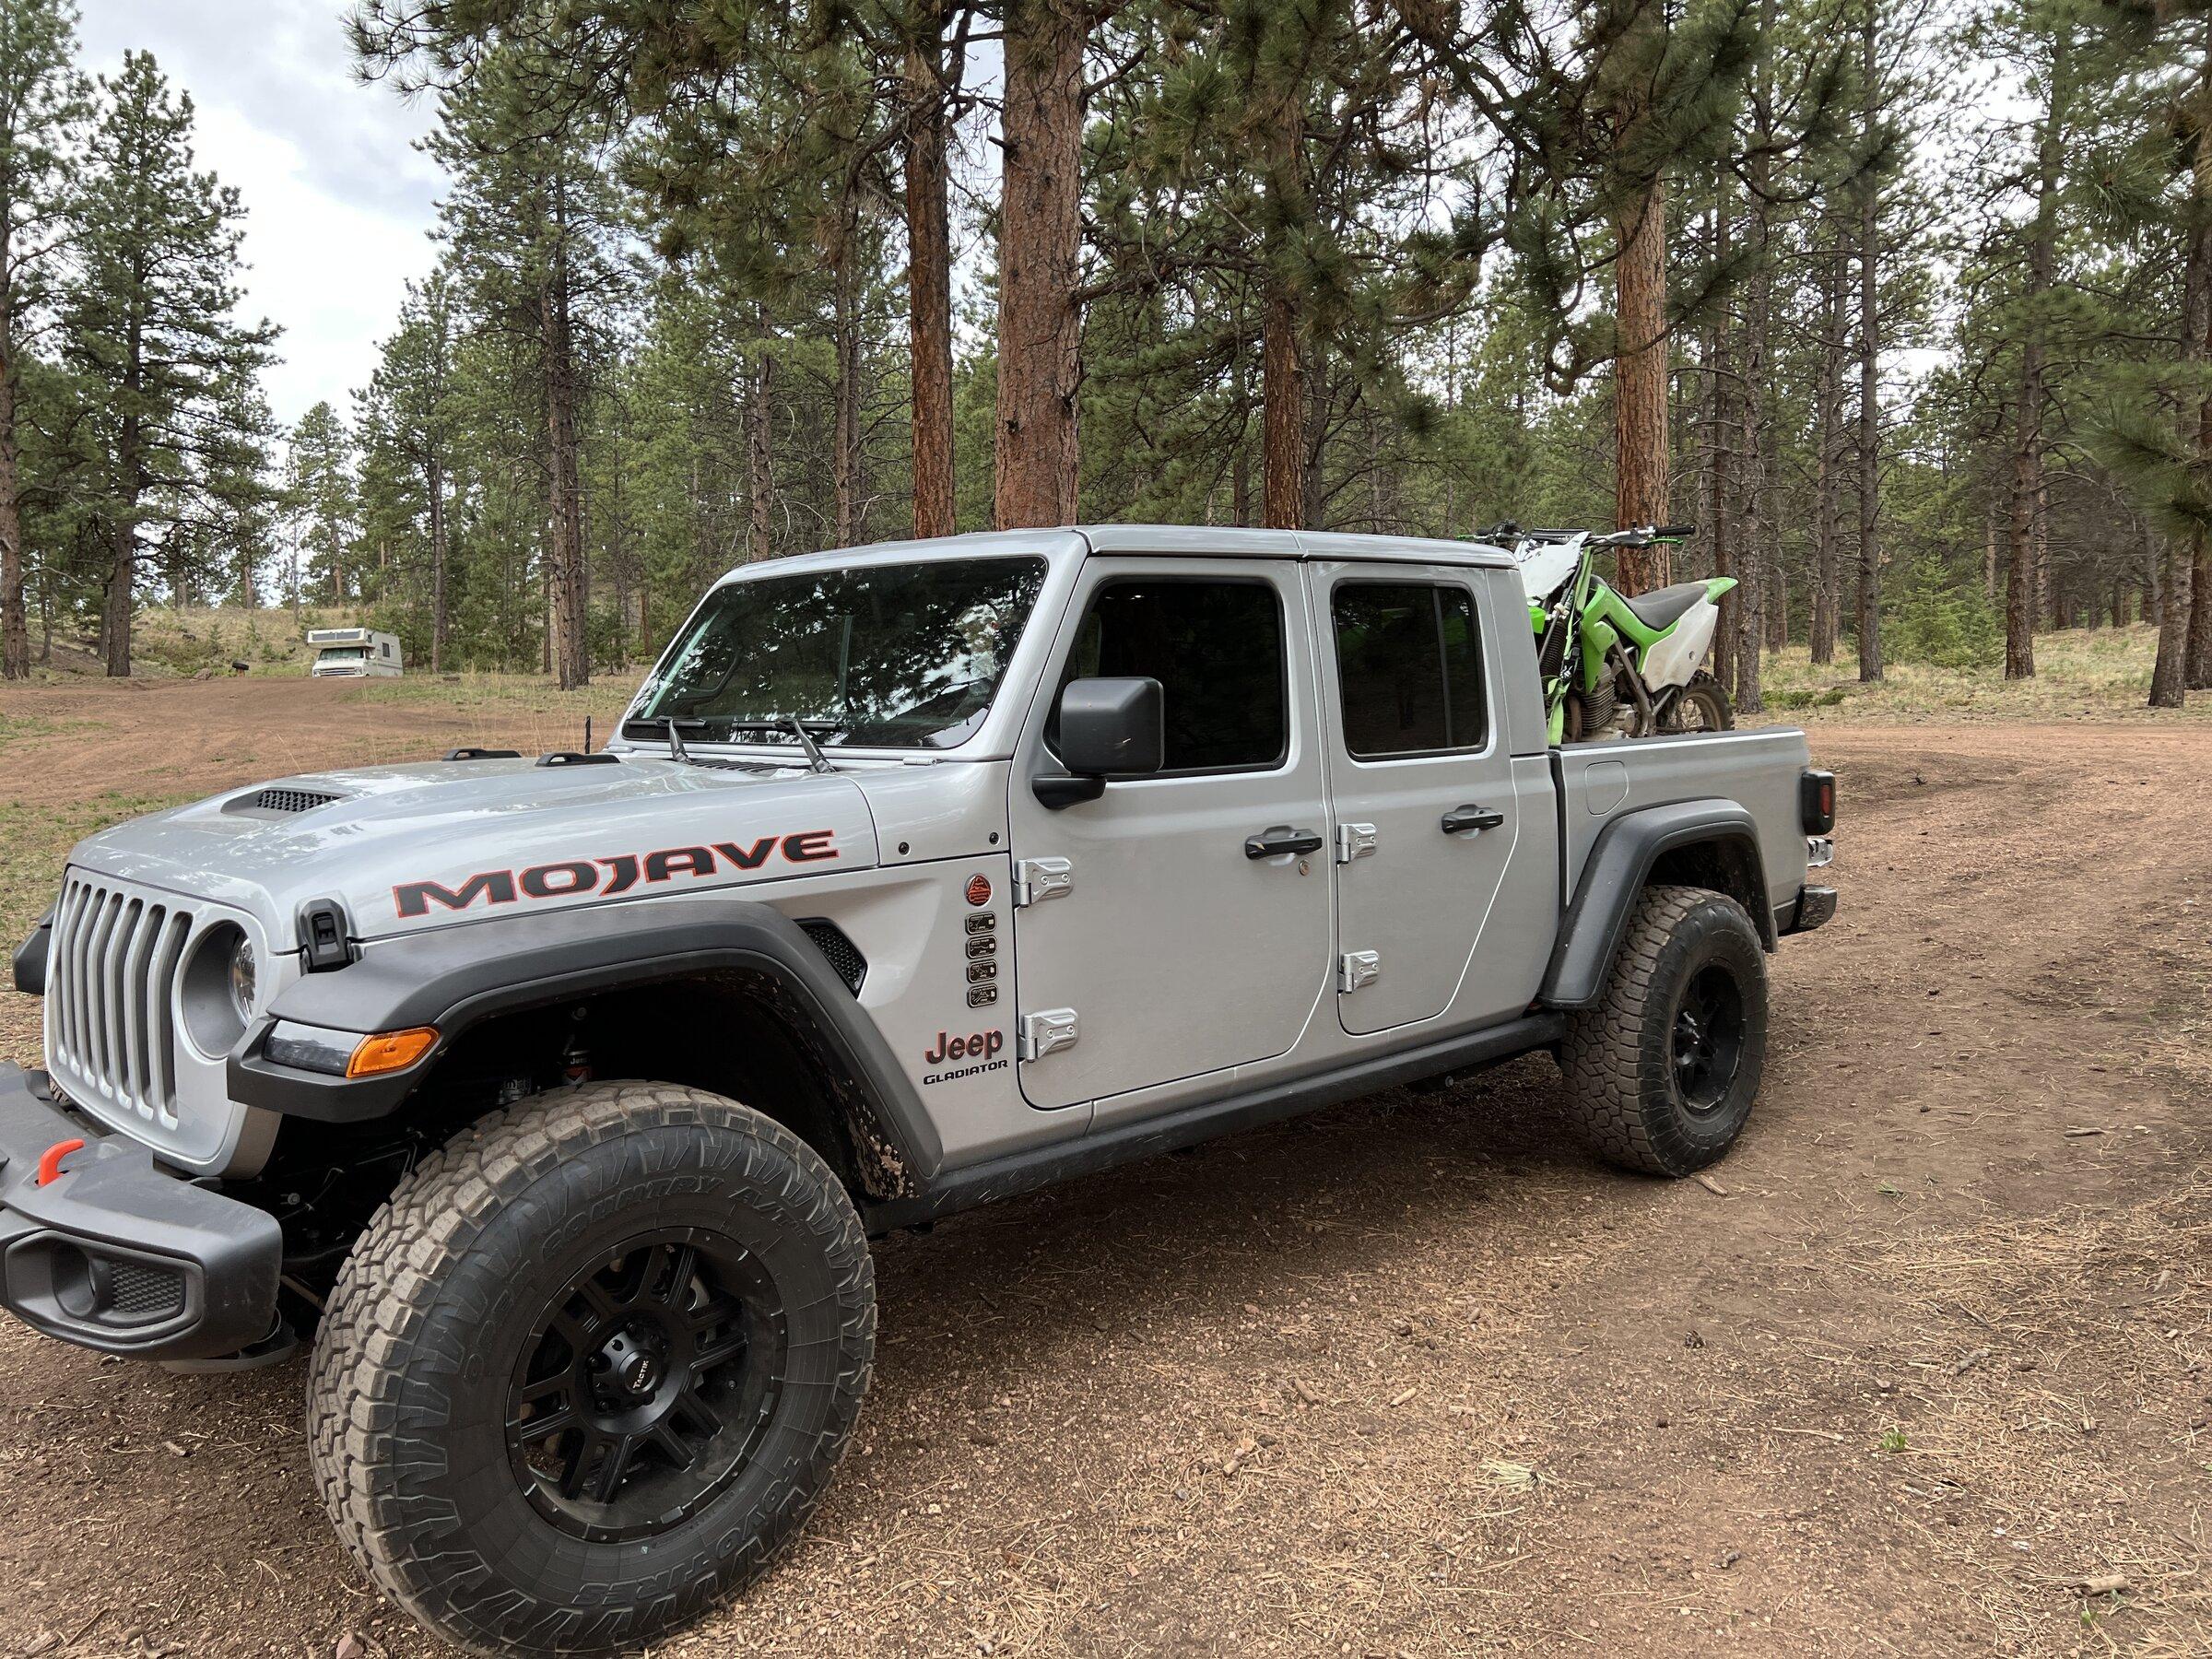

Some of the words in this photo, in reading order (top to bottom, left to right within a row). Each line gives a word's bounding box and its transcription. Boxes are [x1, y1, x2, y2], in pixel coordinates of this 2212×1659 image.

[392, 829, 840, 919] MOJAVE
[924, 1030, 1003, 1065] Jeep
[924, 1059, 1008, 1085] GLADIATOR
[540, 1174, 725, 1265] COUNTRY
[716, 1455, 803, 1559] TOYO
[571, 1551, 711, 1606] TIRES
